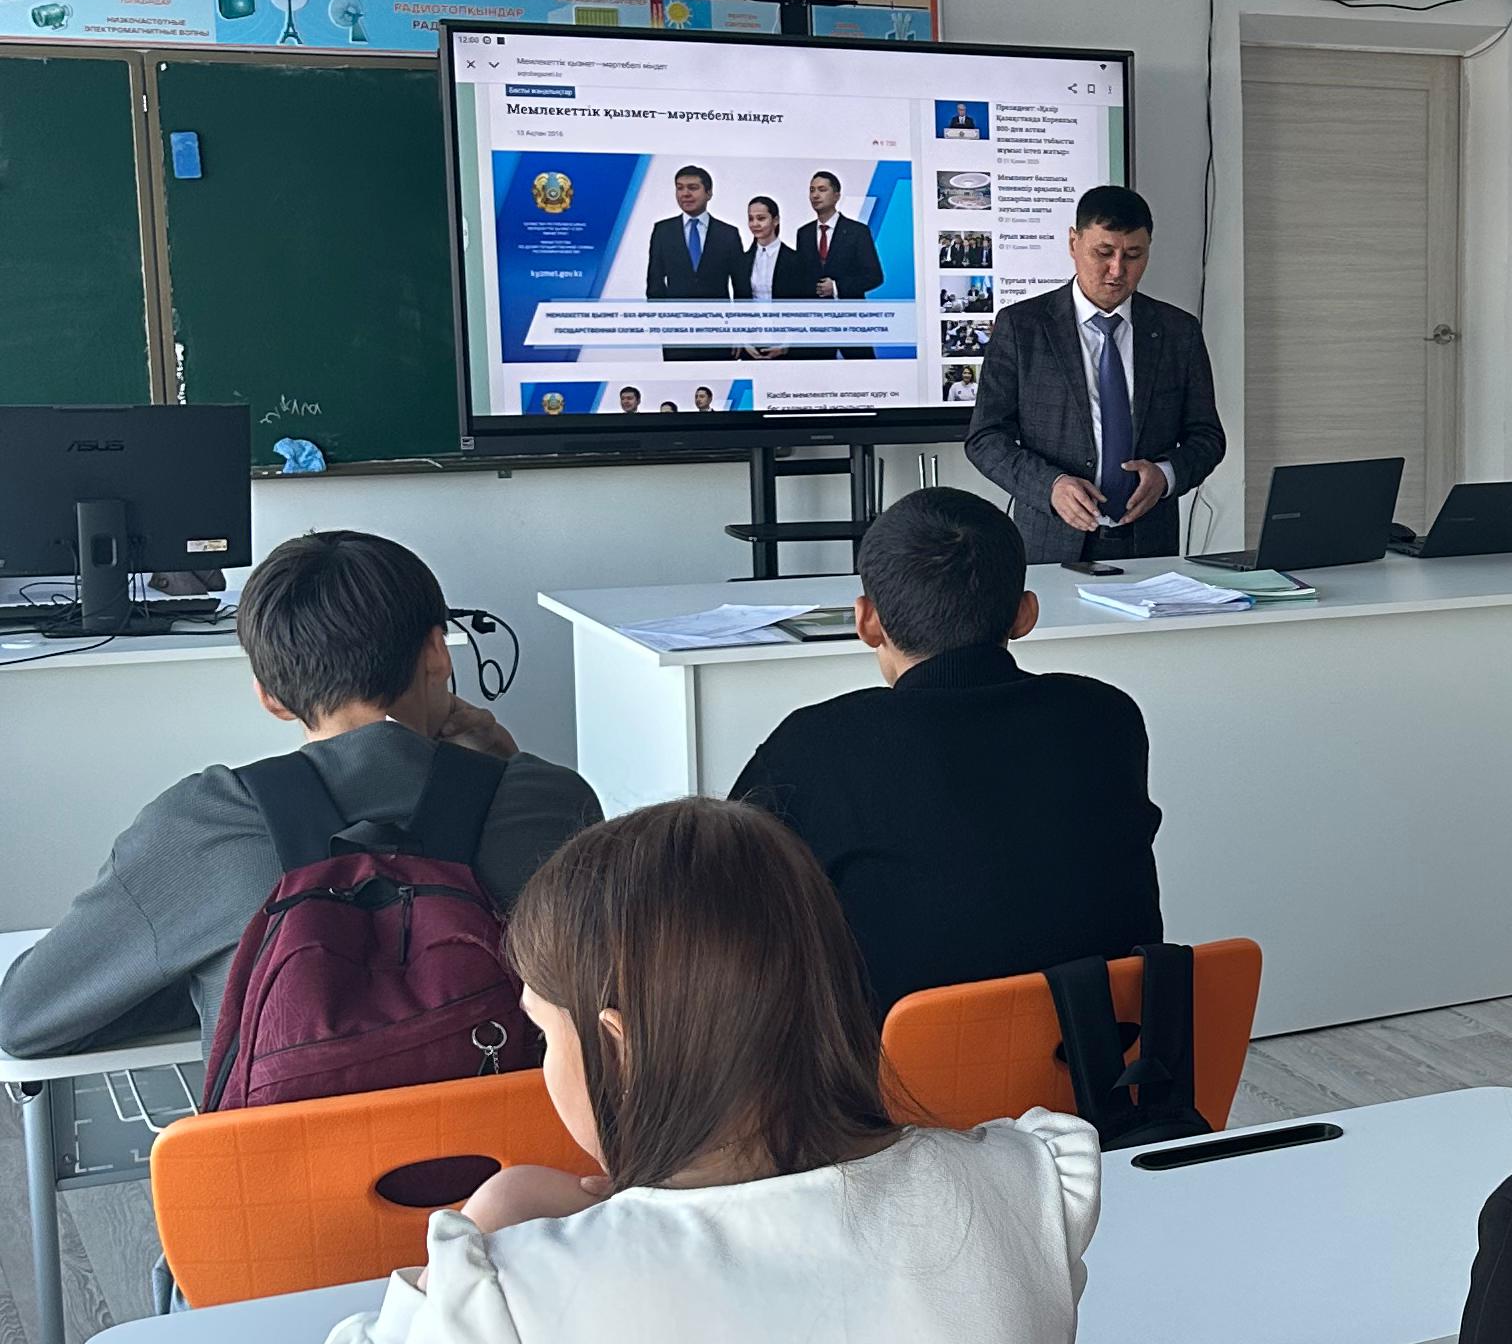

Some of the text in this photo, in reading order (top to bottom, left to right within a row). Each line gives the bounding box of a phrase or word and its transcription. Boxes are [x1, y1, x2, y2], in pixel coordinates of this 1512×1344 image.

[507, 103, 600, 117] Мемлекеттік
[737, 112, 784, 125] міндет
[67, 440, 125, 452] ASUS
